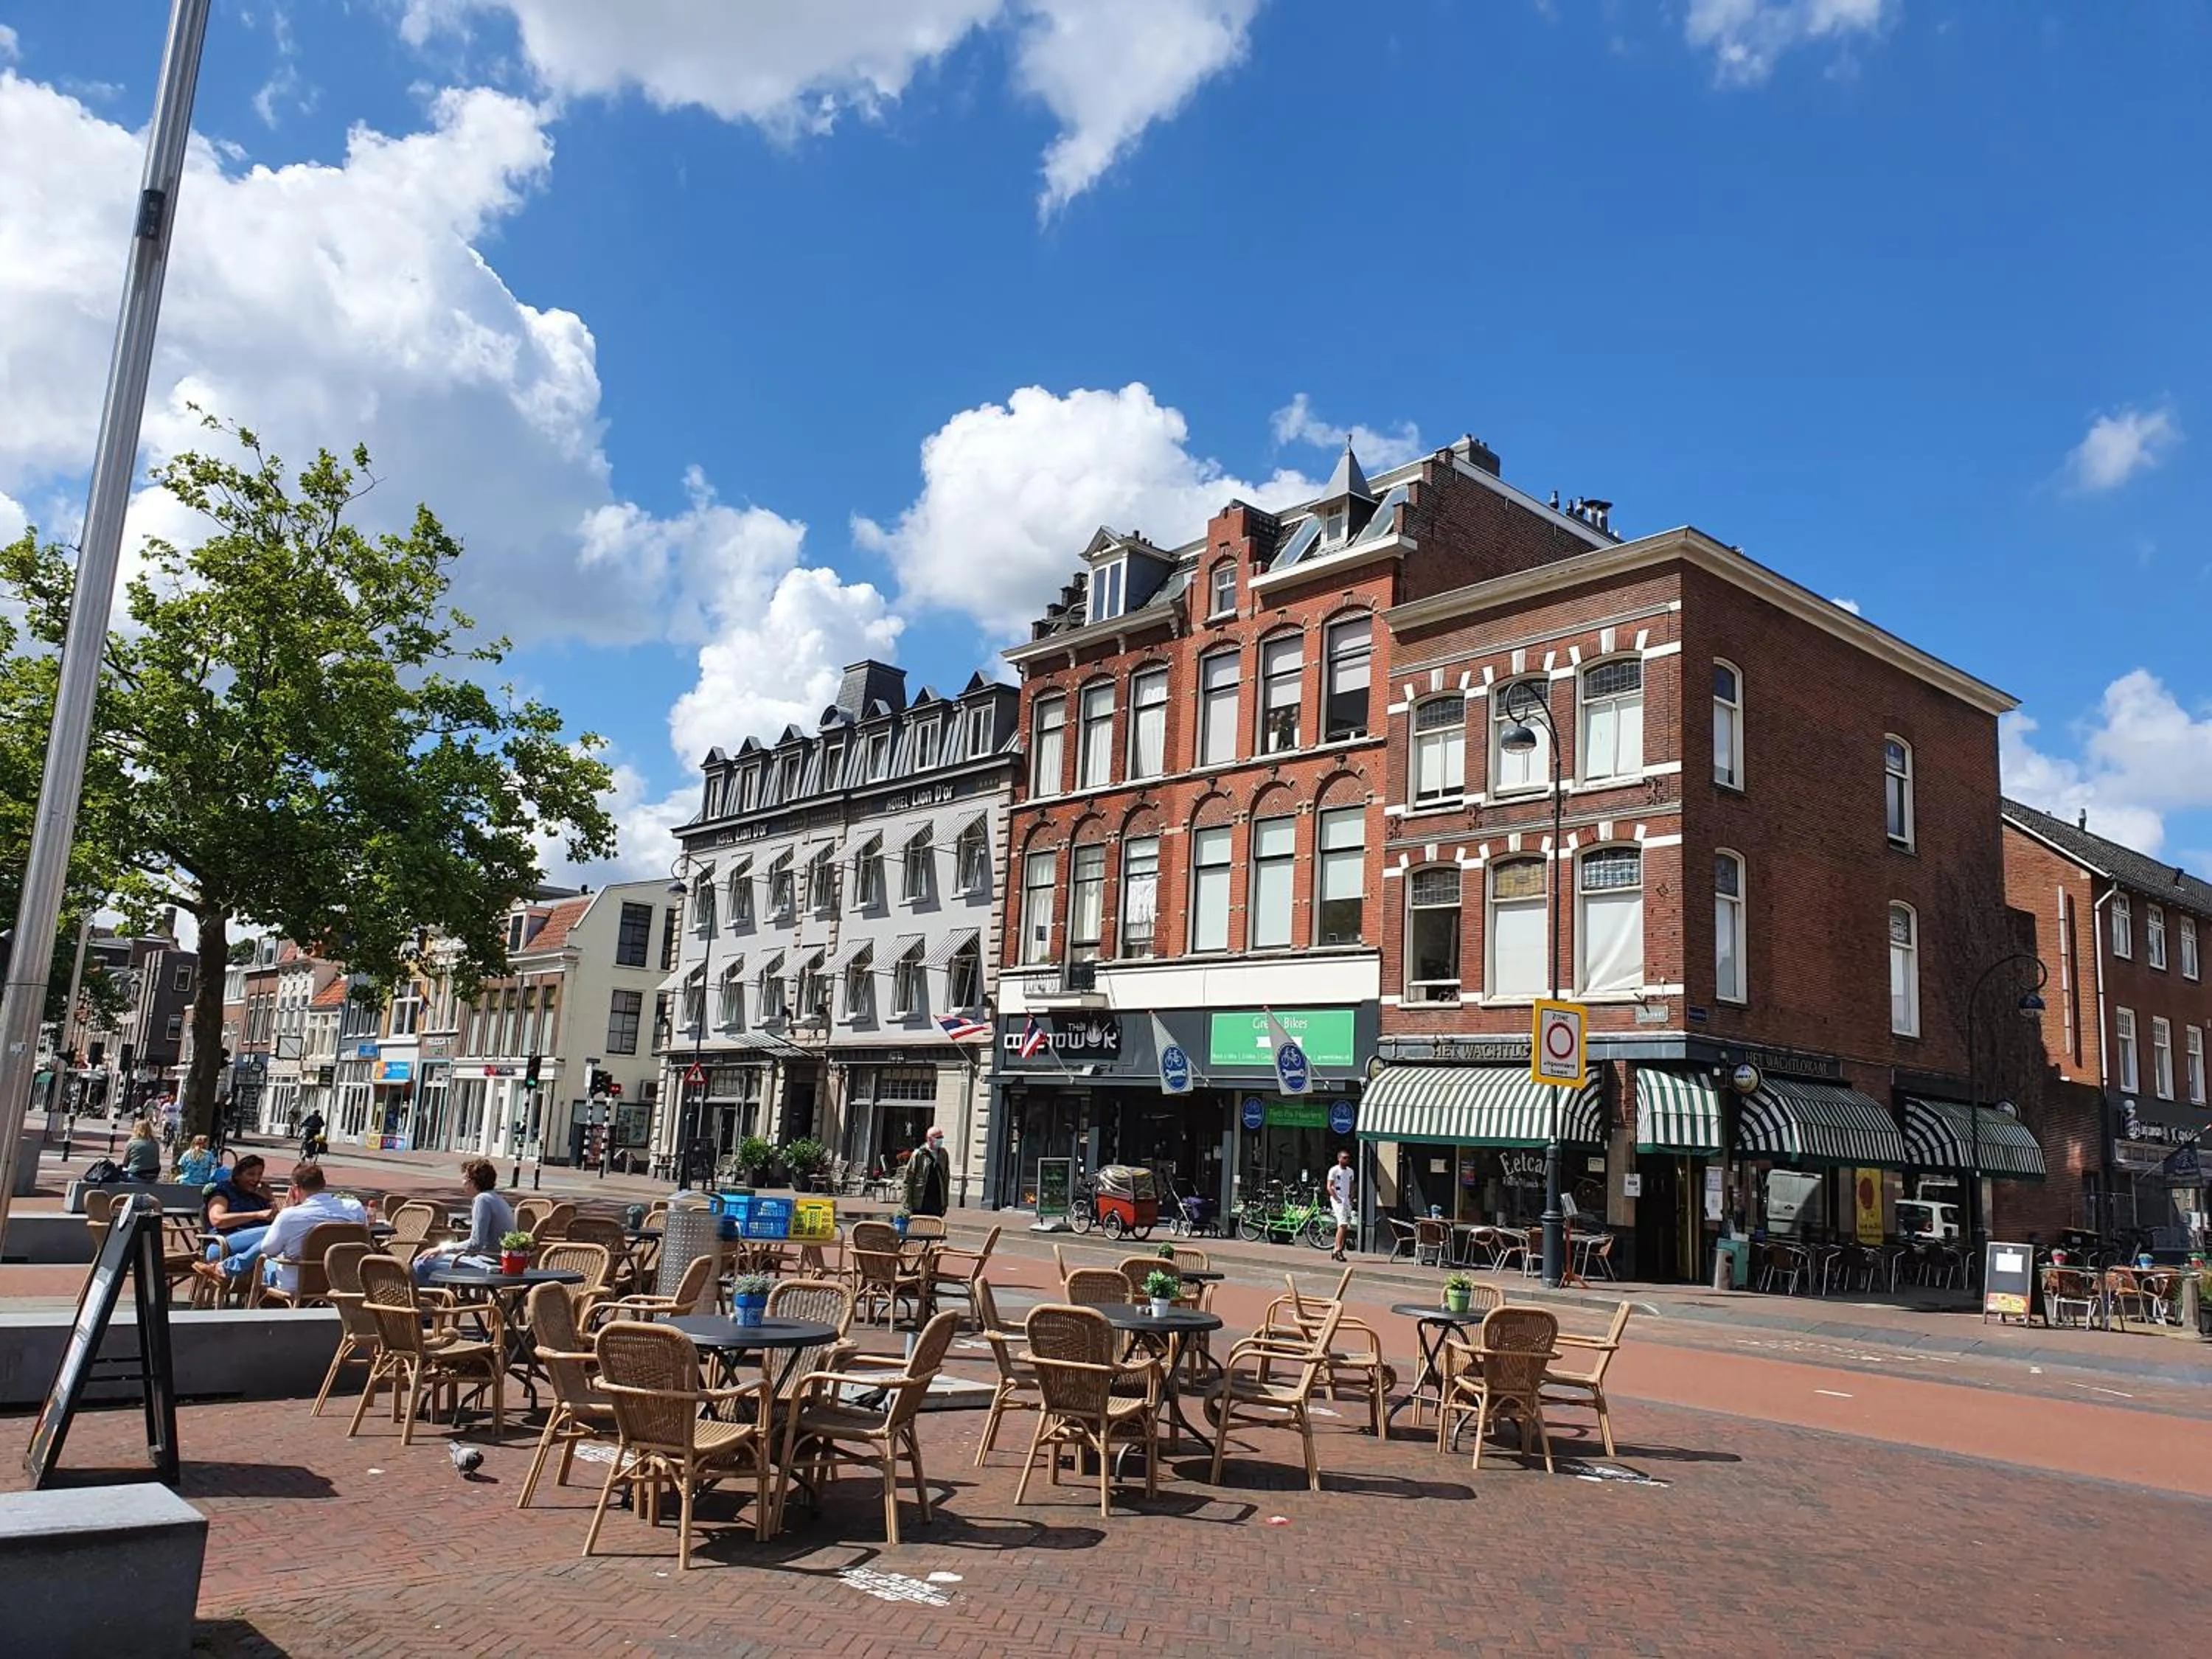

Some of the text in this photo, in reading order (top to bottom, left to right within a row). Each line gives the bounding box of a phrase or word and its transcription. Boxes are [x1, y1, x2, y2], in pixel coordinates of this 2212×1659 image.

[886, 796, 908, 811] HOTEL
[1253, 1016, 1308, 1029] Gre Bikes
[1433, 1044, 1531, 1059] HET WACHTLO
[1745, 1051, 1762, 1065] HET
[1499, 1152, 1548, 1176] Eetca
